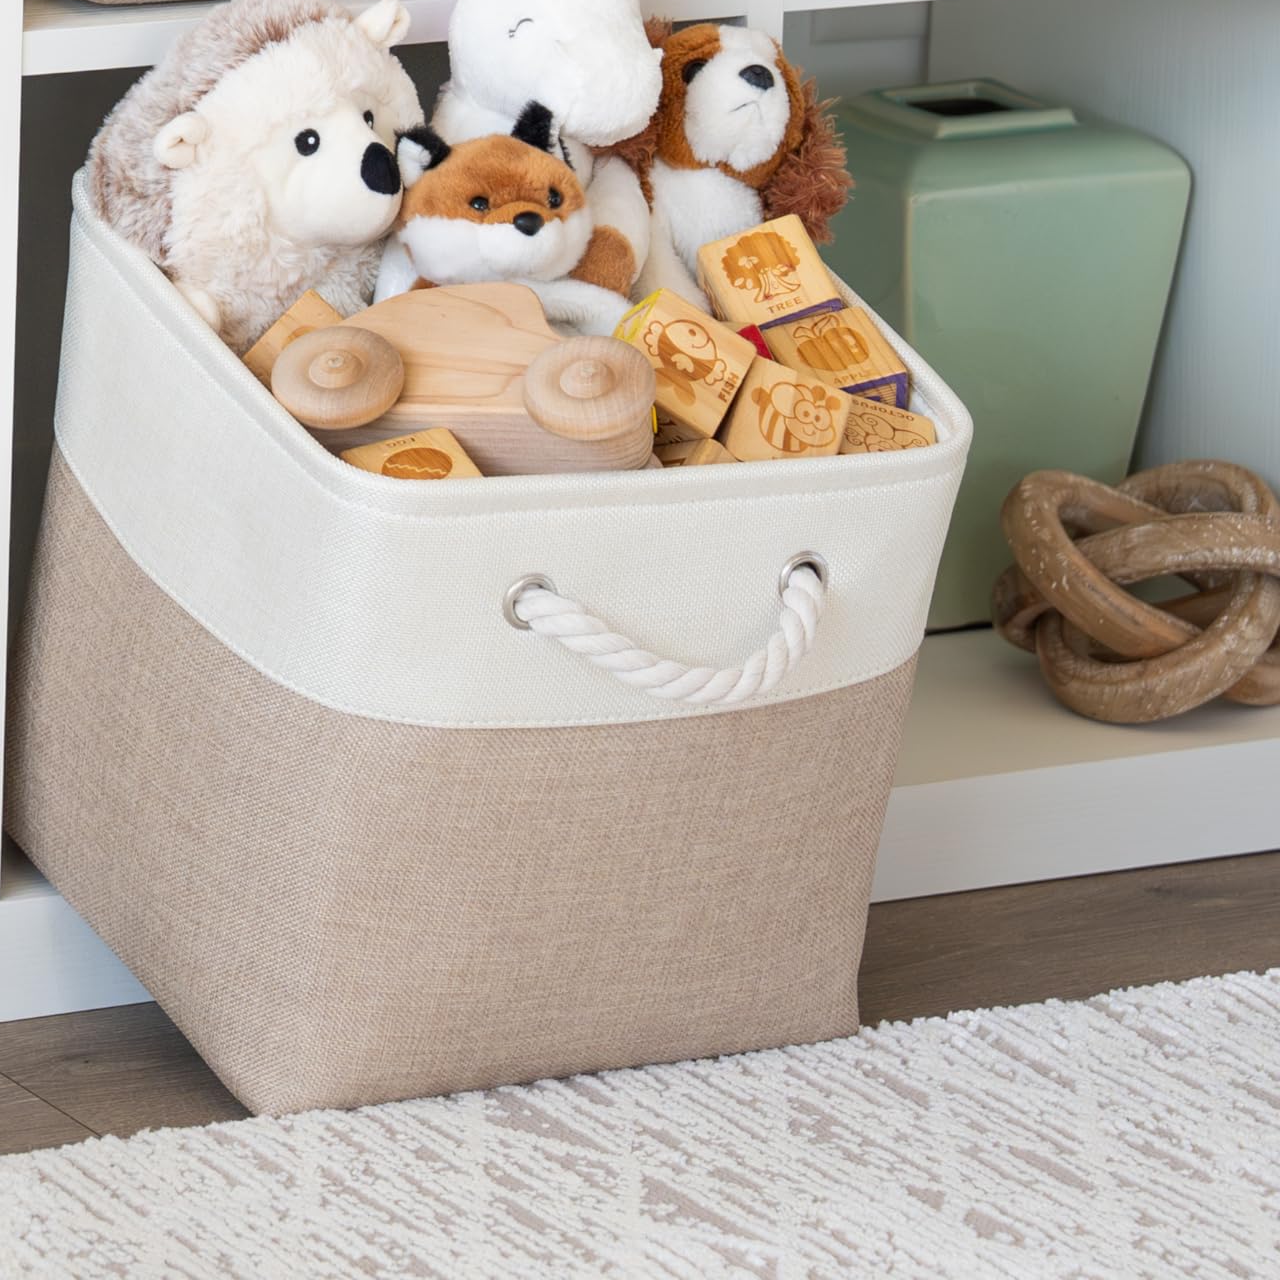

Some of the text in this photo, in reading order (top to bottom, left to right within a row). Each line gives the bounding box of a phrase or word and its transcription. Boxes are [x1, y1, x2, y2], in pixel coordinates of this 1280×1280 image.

[767, 296, 804, 314] TREE
[834, 371, 870, 384] APPL
[718, 373, 740, 403] FISH
[852, 399, 915, 422] OCTOPUS
